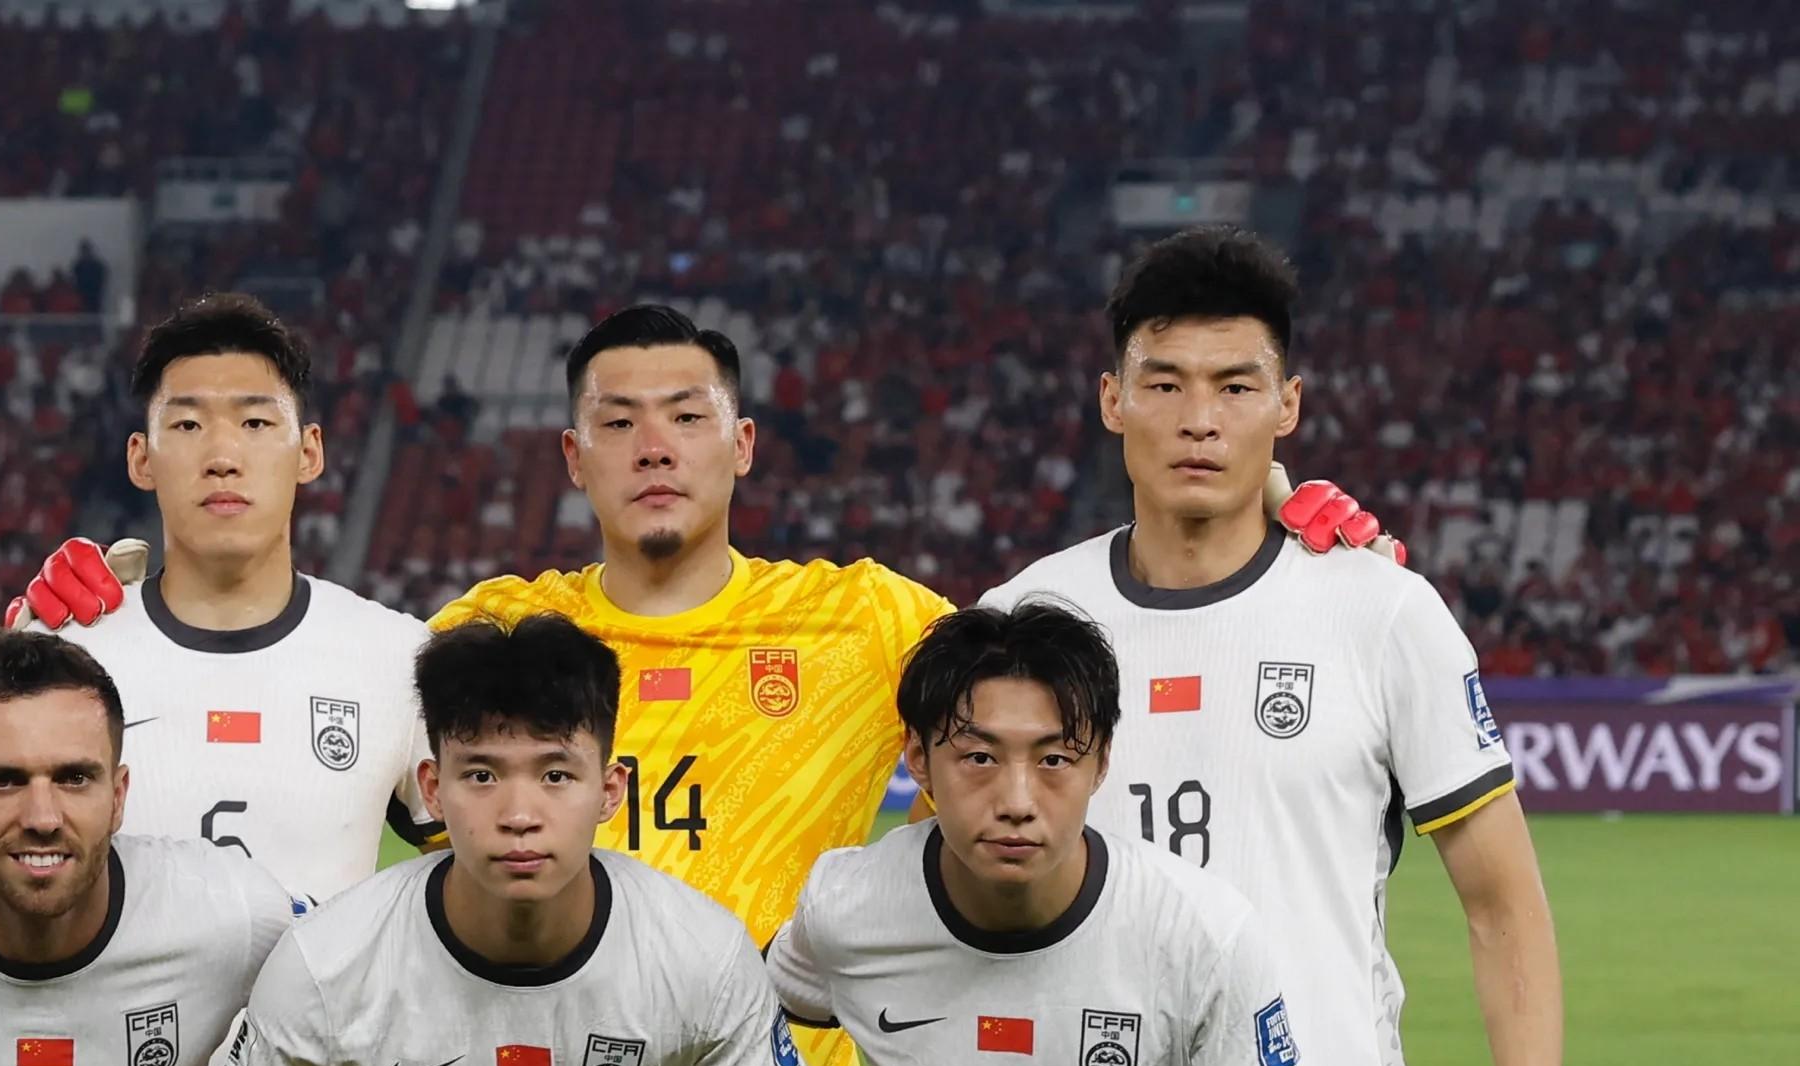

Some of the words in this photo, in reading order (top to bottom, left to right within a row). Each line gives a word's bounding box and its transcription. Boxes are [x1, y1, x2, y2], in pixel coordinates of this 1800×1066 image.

[751, 651, 795, 664] CFA
[1264, 667, 1308, 682] CFA
[316, 701, 355, 718] CFA
[617, 755, 707, 850] 14
[1128, 779, 1211, 868] 18
[132, 1010, 174, 1031] CFA
[1087, 1014, 1135, 1031] CFA
[591, 1038, 639, 1056] CFA
